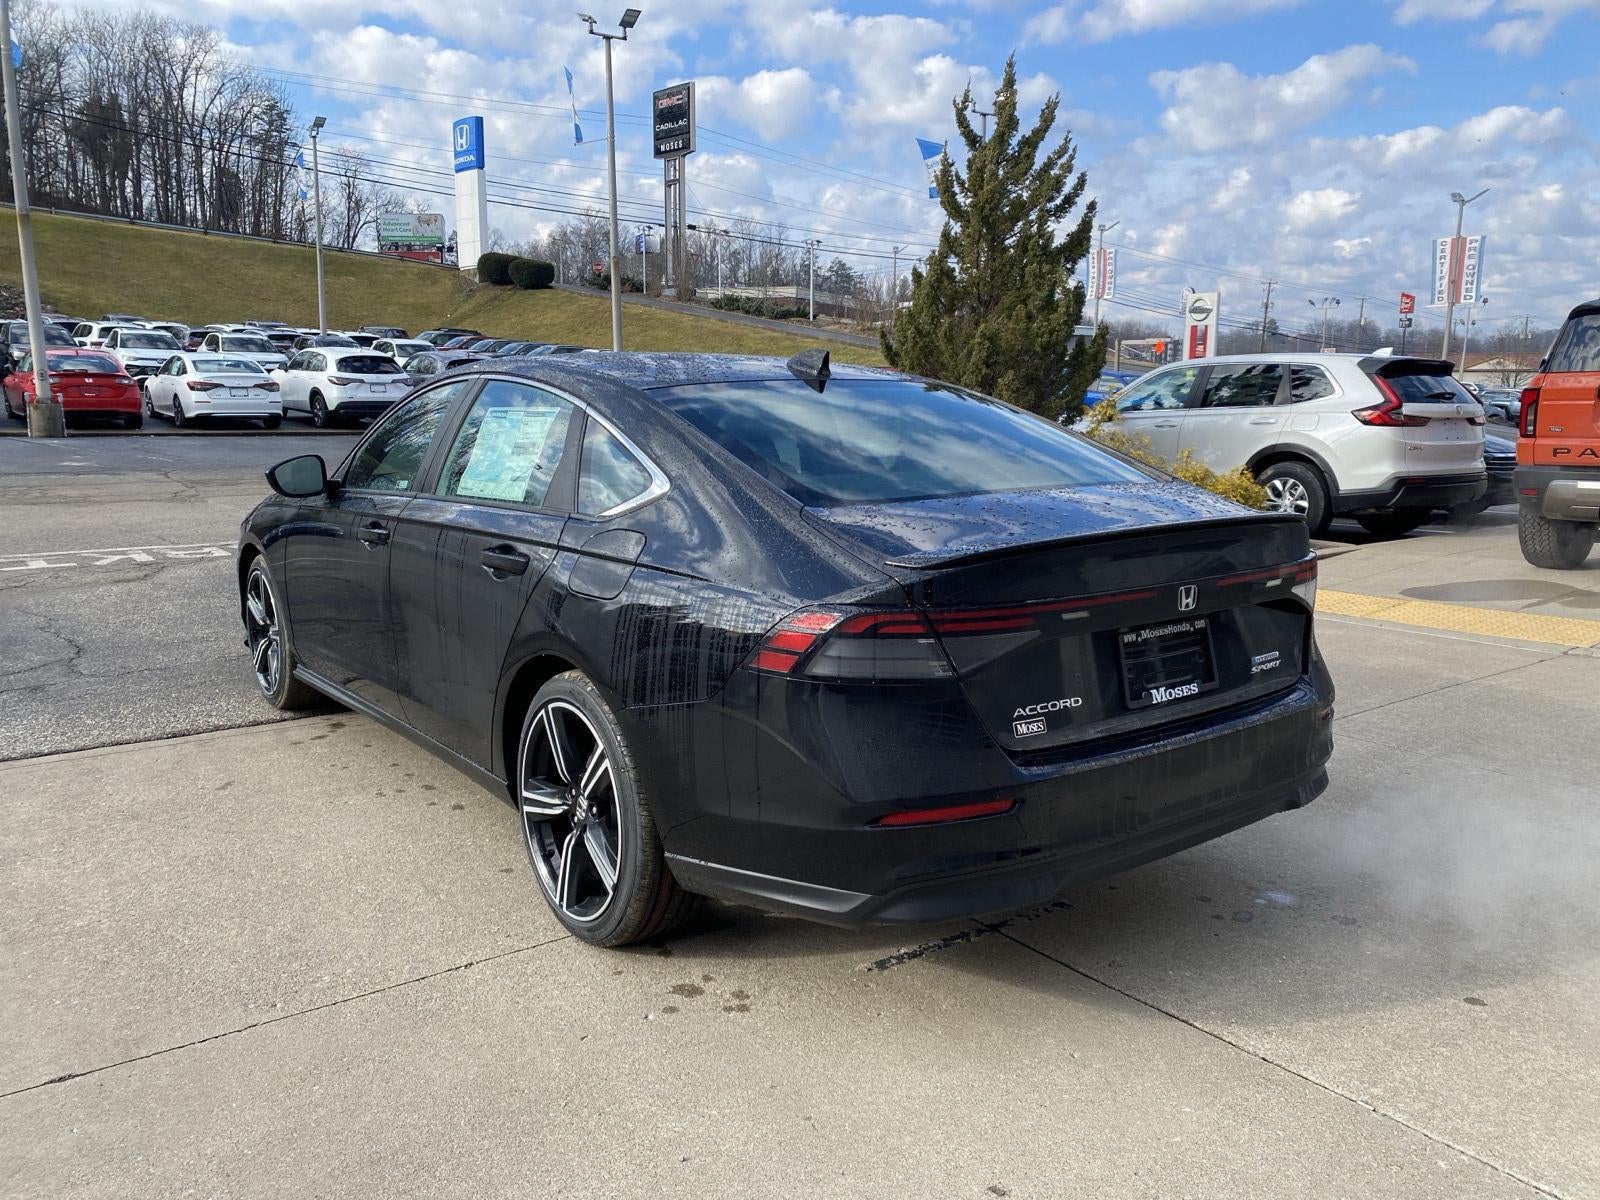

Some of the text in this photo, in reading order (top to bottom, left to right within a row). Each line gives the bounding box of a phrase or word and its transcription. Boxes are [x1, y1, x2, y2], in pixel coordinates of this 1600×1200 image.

[658, 95, 683, 109] GMC
[655, 118, 688, 132] CADILLAC
[660, 140, 683, 152] MOSES
[1467, 238, 1479, 260] PRE
[1437, 240, 1448, 302] CERTIFIED
[1463, 263, 1477, 301] OWNED
[1250, 660, 1281, 674] SPORT
[1150, 683, 1199, 704] MOSES
[1013, 697, 1083, 718] ACCORD
[1016, 721, 1045, 735] MOSES
